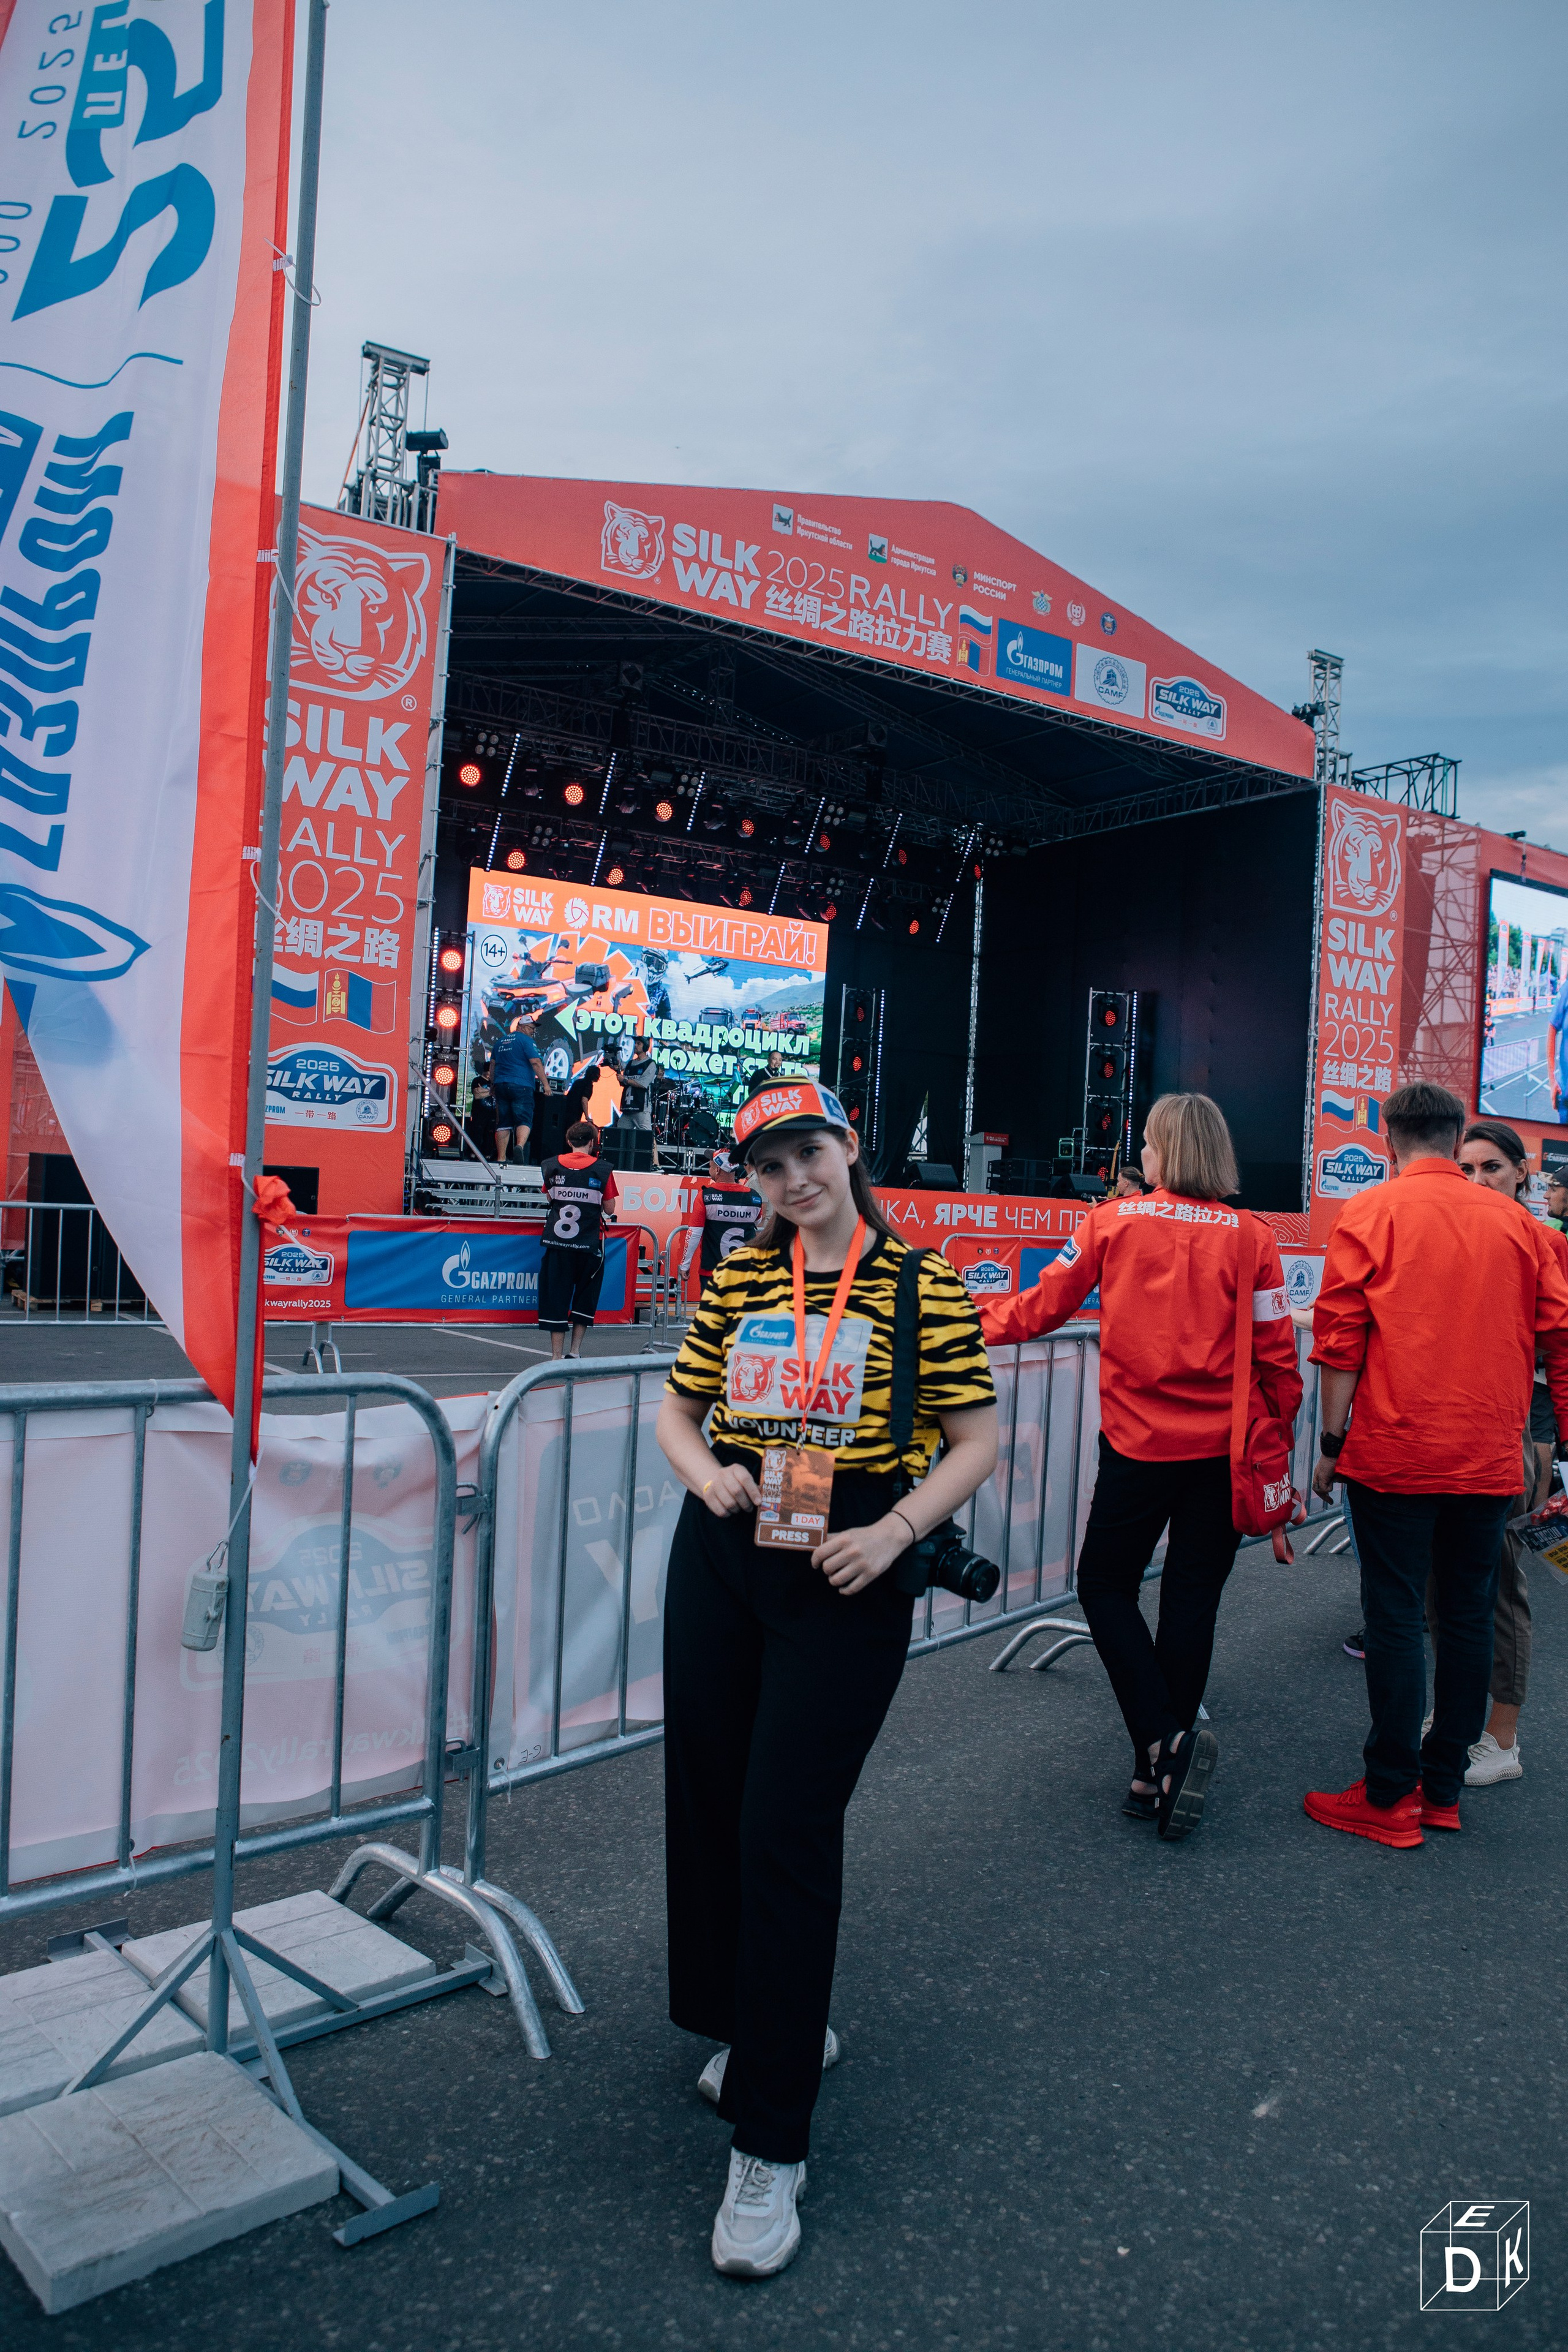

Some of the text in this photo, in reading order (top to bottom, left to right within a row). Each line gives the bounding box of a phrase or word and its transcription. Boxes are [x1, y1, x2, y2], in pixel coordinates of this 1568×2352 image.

[797, 513, 842, 536] Правительство
[796, 527, 853, 551] Иркутской области
[672, 523, 760, 577] SILK
[672, 556, 758, 609] WAY
[766, 550, 954, 630] 2025 RALLY
[973, 571, 1017, 592] МИНСПОРТ
[973, 583, 1007, 601] РОССИИ
[764, 584, 953, 666] 丝绸之路拉力赛
[1023, 654, 1063, 679] ГАЗПРОМ
[1006, 667, 1062, 688] ГЕНЕРАЛЬНЫЙ ПАРТНЕР
[1098, 686, 1123, 698] CAMF
[1158, 688, 1219, 715] SILK WAY
[1177, 706, 1201, 717] RALLY
[513, 905, 554, 925] WAY
[513, 888, 554, 909] SILK
[648, 907, 817, 966] ВЫИГРАЙ!
[483, 942, 505, 958] 14+
[1327, 917, 1396, 962] SILK
[1327, 952, 1396, 995] WAY
[1324, 992, 1394, 1027] RALLY
[1323, 1021, 1394, 1065] 2025
[296, 1058, 340, 1072] 2025
[323, 1074, 380, 1095] WAY
[1321, 1059, 1392, 1093] 丝绸之路
[292, 1090, 342, 1101] RALLY
[760, 1088, 802, 1107] SILK
[265, 1105, 286, 1114] ZPROM
[294, 1109, 337, 1120] 一带一路
[761, 1099, 803, 1117] WAY
[1325, 1161, 1382, 1177] SILK WAY
[1344, 1154, 1364, 1163] 2025
[558, 1191, 589, 1199] PODIUM
[554, 1204, 581, 1239] 8
[717, 1210, 752, 1218] PODIUM
[880, 1199, 926, 1229] КА,
[932, 1202, 998, 1228] ЯРЧЕ
[1005, 1206, 1051, 1231] ЧЕМ
[720, 1227, 747, 1258] 6
[471, 1271, 538, 1290] GAZPROM
[265, 1299, 331, 1309] kwayrally2025
[441, 1294, 538, 1304] GENERAL PARTNER
[779, 1383, 856, 1415] WAY
[801, 1516, 821, 1525] DAY
[771, 1529, 810, 1544] PRESS
